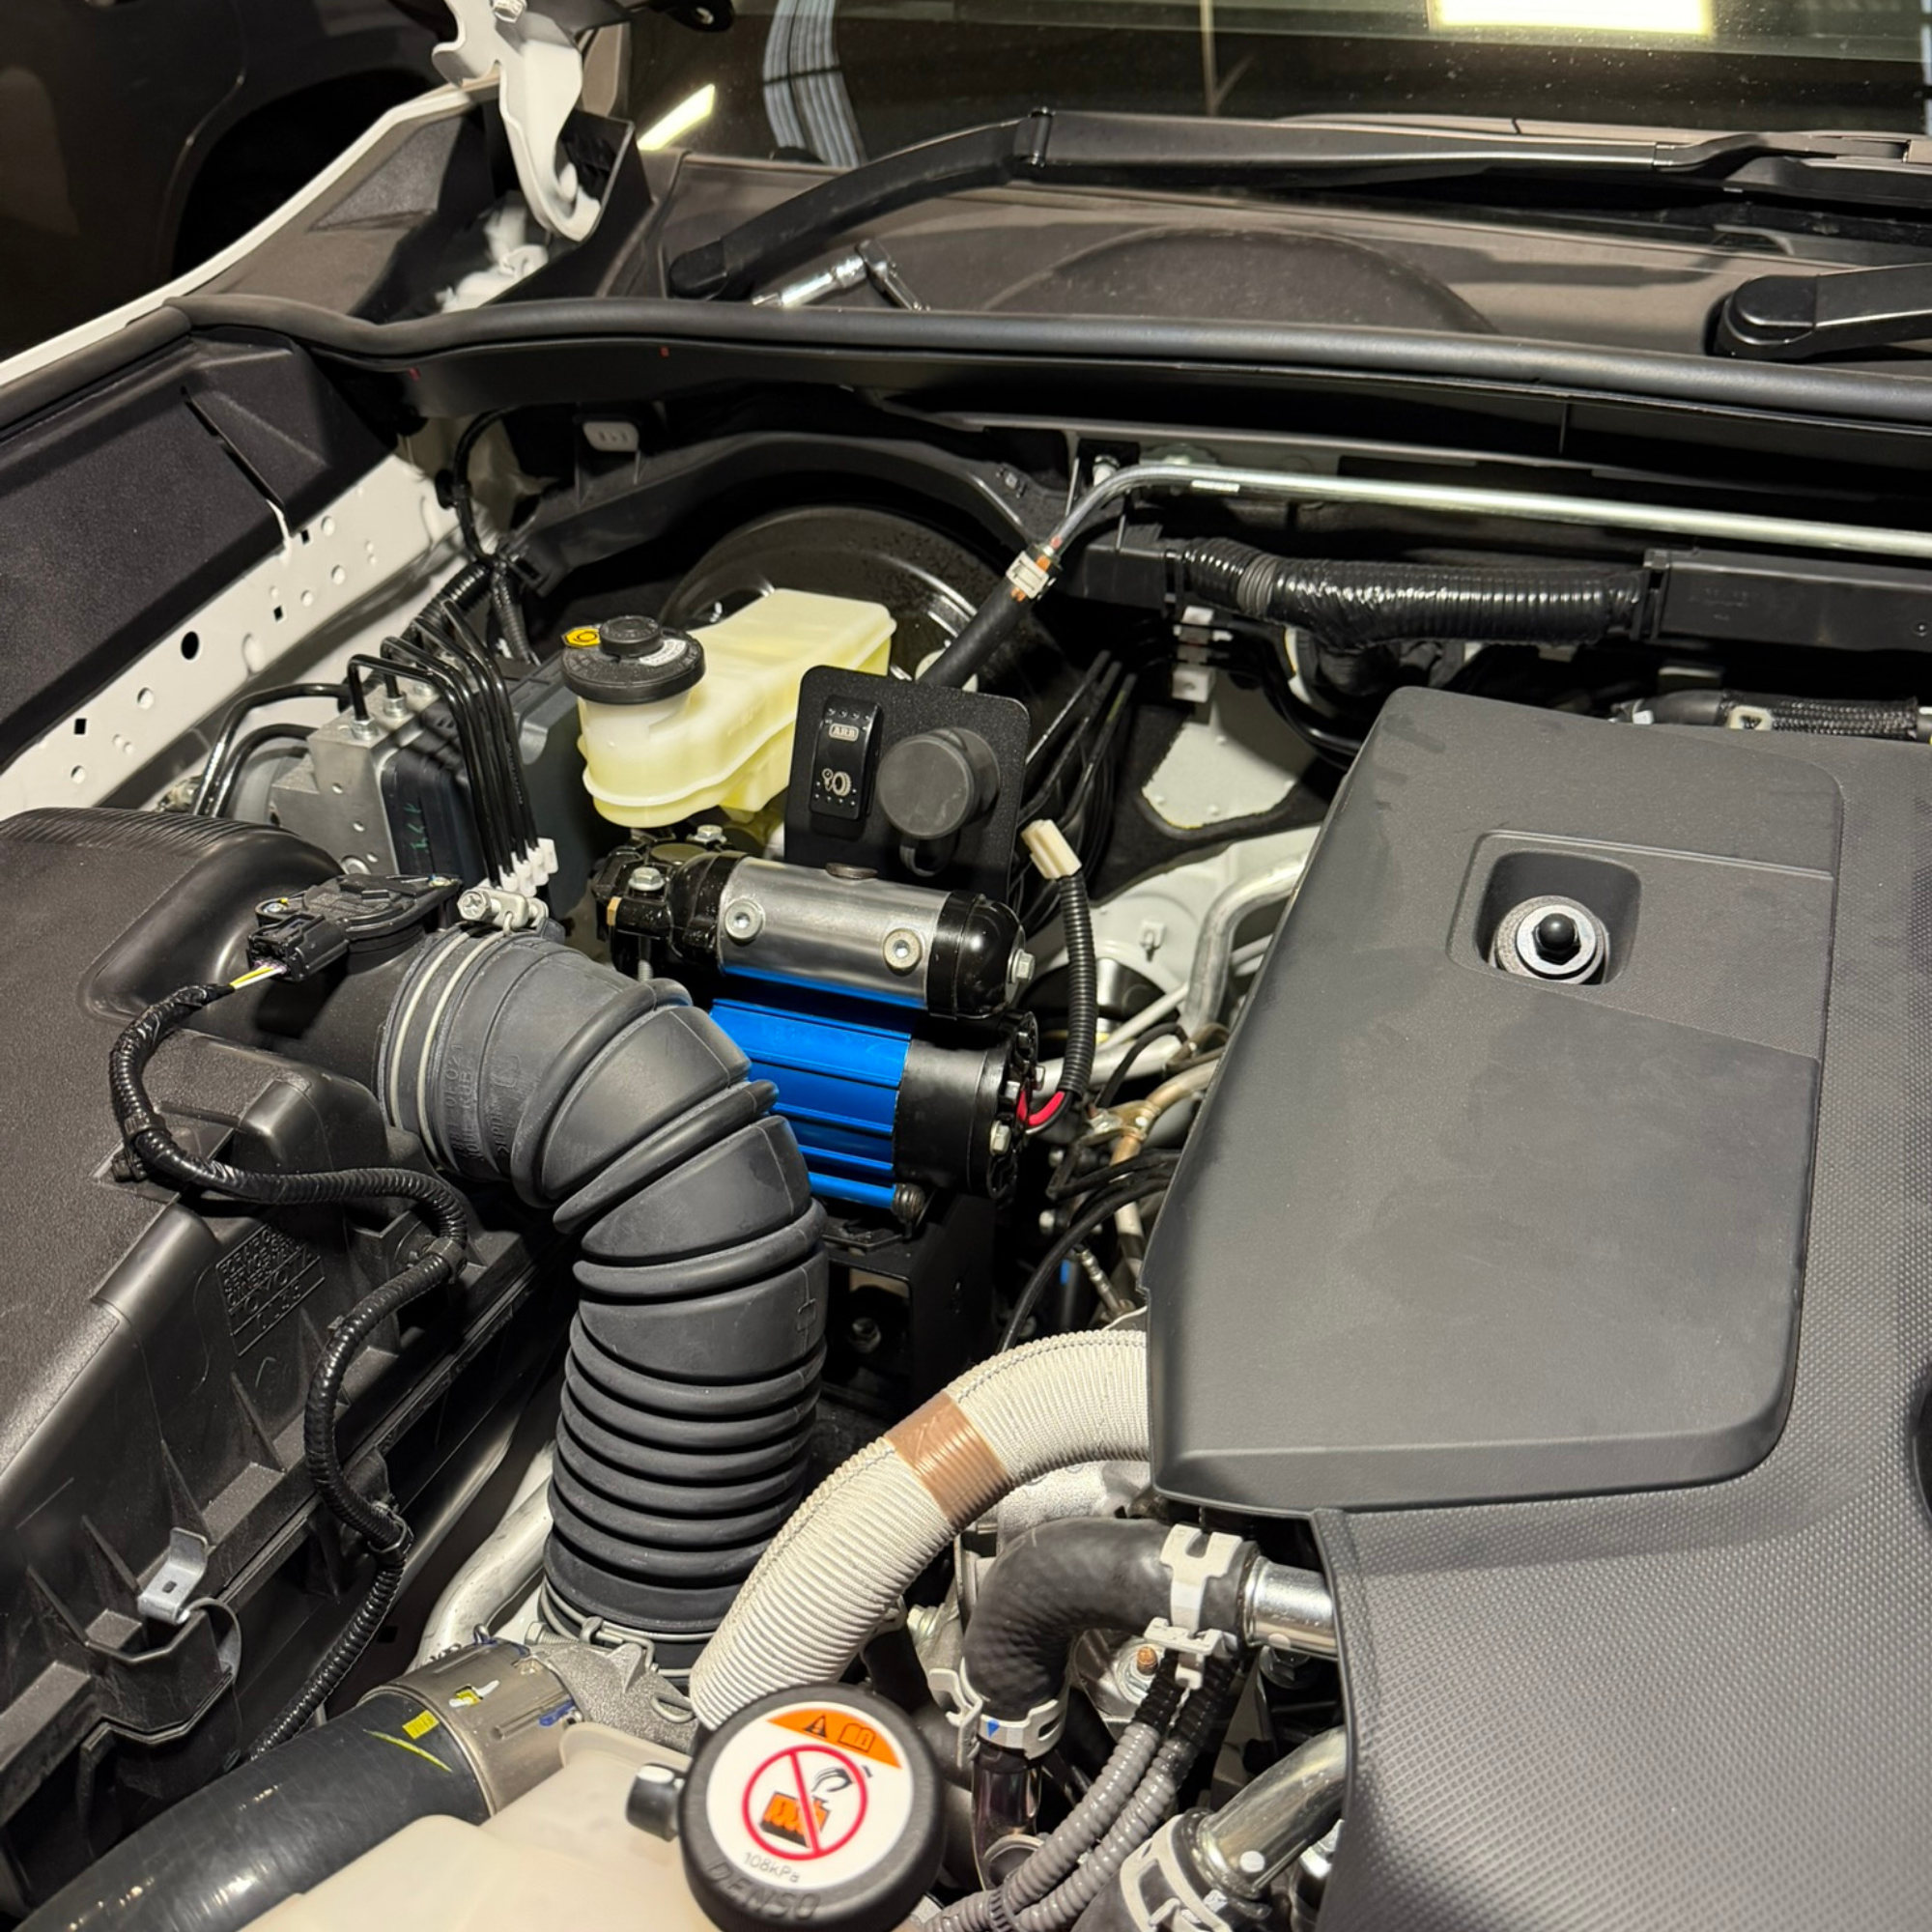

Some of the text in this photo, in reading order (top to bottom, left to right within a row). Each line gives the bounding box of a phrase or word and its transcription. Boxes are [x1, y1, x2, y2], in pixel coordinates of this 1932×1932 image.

[830, 724, 858, 740] ARB
[744, 1851, 801, 1883] 108kPa
[708, 1861, 821, 1918] DENSO
